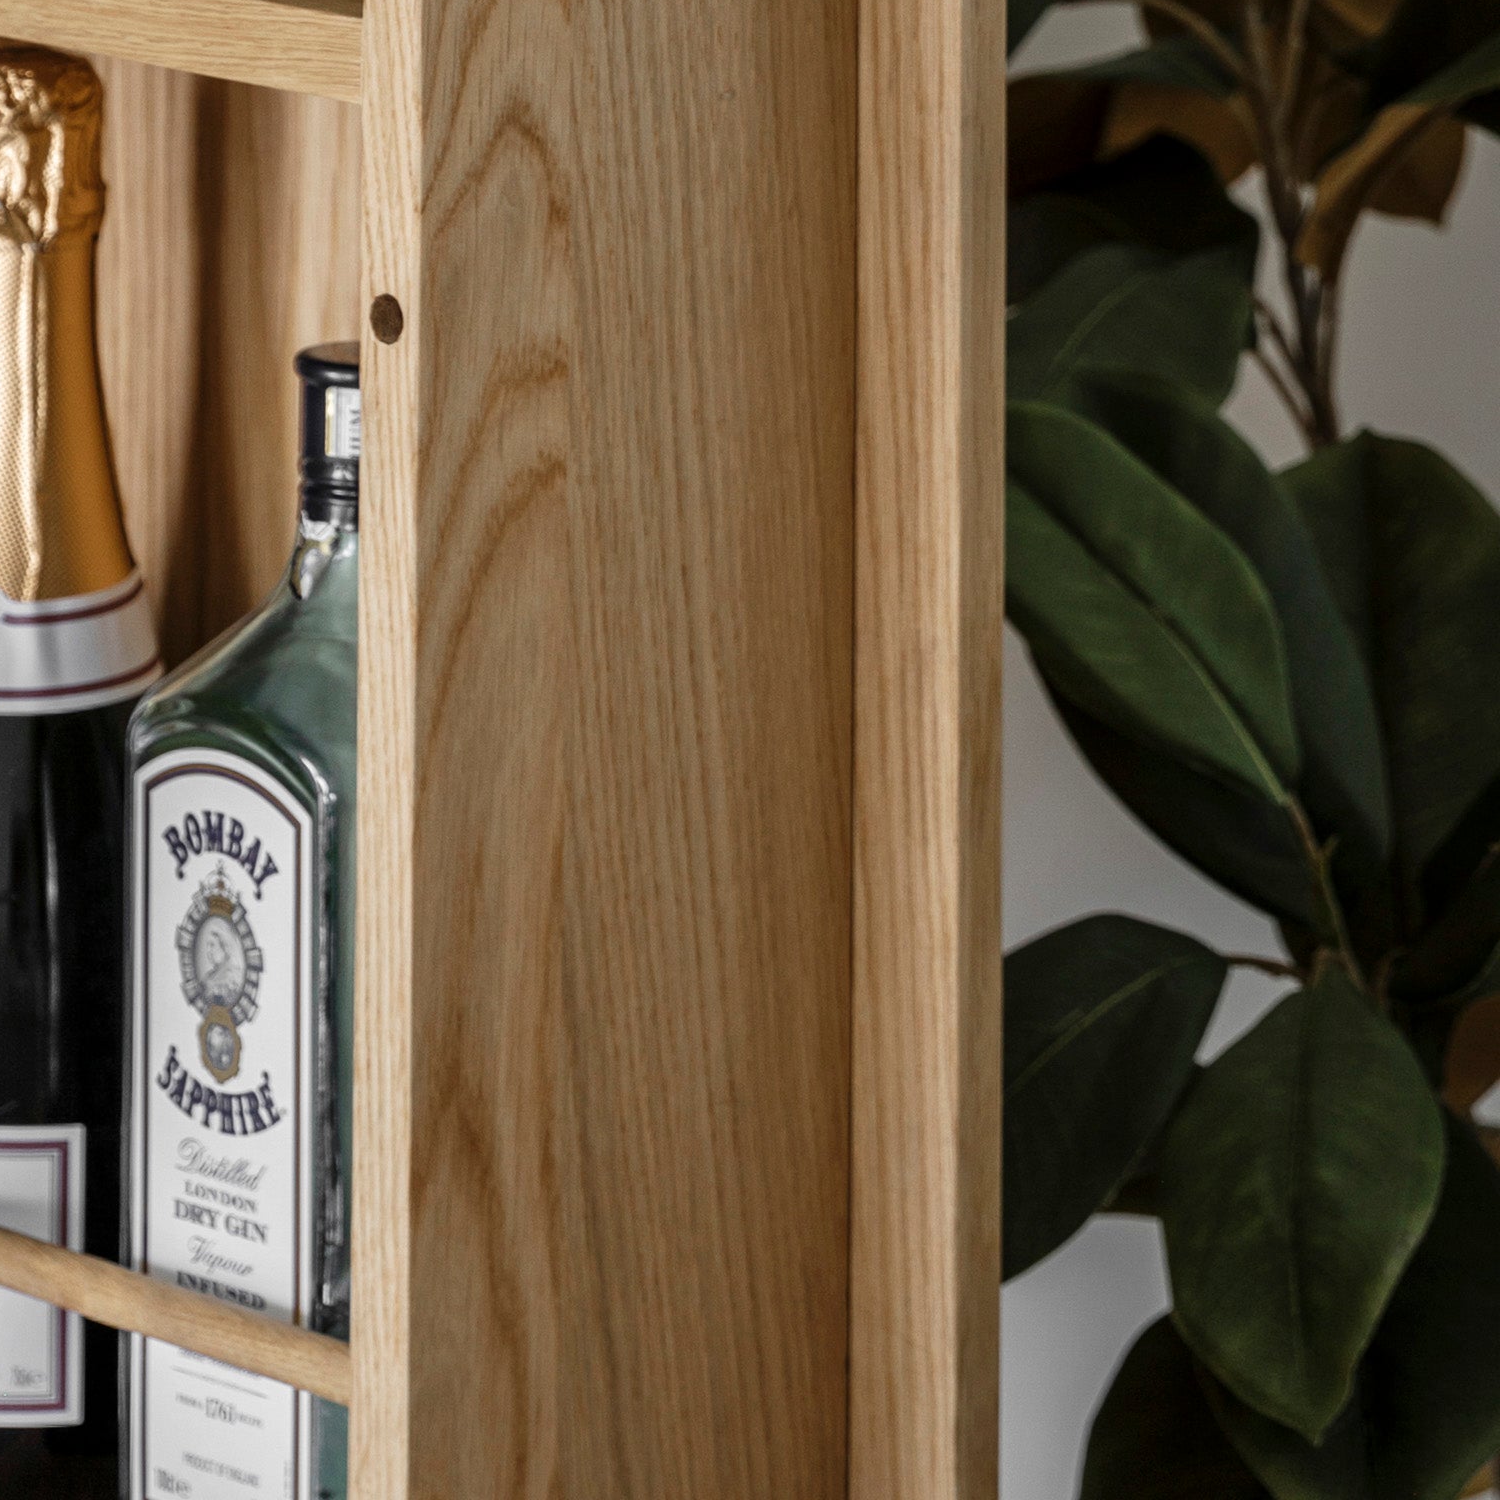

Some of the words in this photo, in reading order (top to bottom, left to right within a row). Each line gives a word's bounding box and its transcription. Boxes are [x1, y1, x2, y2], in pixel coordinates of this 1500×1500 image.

[162, 810, 279, 900] BOMBAY
[157, 1046, 281, 1136] SAPPHIRE
[174, 1136, 268, 1191] Distilled
[184, 1179, 258, 1213] LONDON
[173, 1198, 220, 1229] DRY
[224, 1211, 268, 1244] GIN
[187, 1234, 254, 1276] Vapour
[176, 1270, 267, 1311] INFUSED
